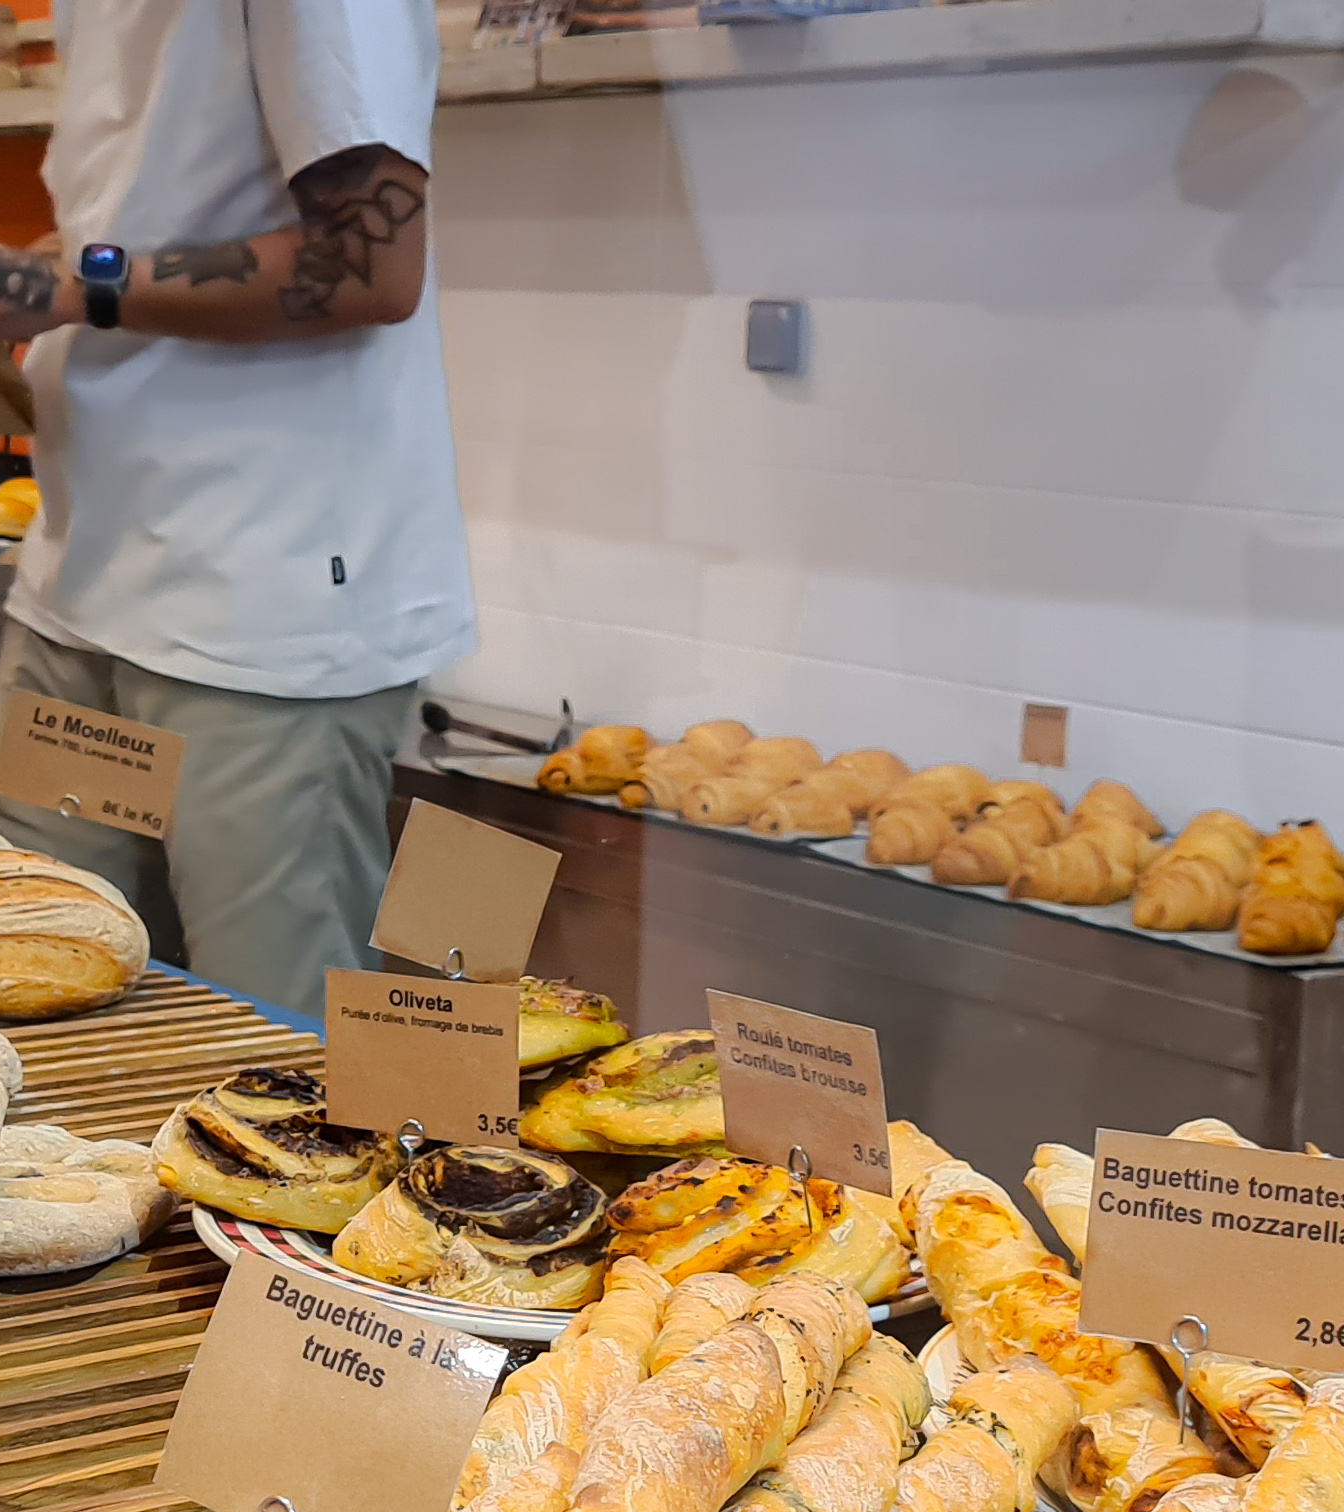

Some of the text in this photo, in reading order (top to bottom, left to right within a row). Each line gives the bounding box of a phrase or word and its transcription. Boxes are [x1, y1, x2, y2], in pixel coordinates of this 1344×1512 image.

[33, 707, 156, 756] Le Moelleux
[389, 988, 453, 1013] Oliveta
[455, 1021, 469, 1033] de
[737, 1022, 853, 1067] Roulé tomates
[730, 1046, 867, 1097] Confites brousse
[477, 1113, 519, 1136] 3,5€
[1103, 1157, 1239, 1195] Baguettine
[1098, 1191, 1203, 1226] Confites
[265, 1273, 456, 1371] Baguettine à la
[302, 1333, 387, 1388] truffes
